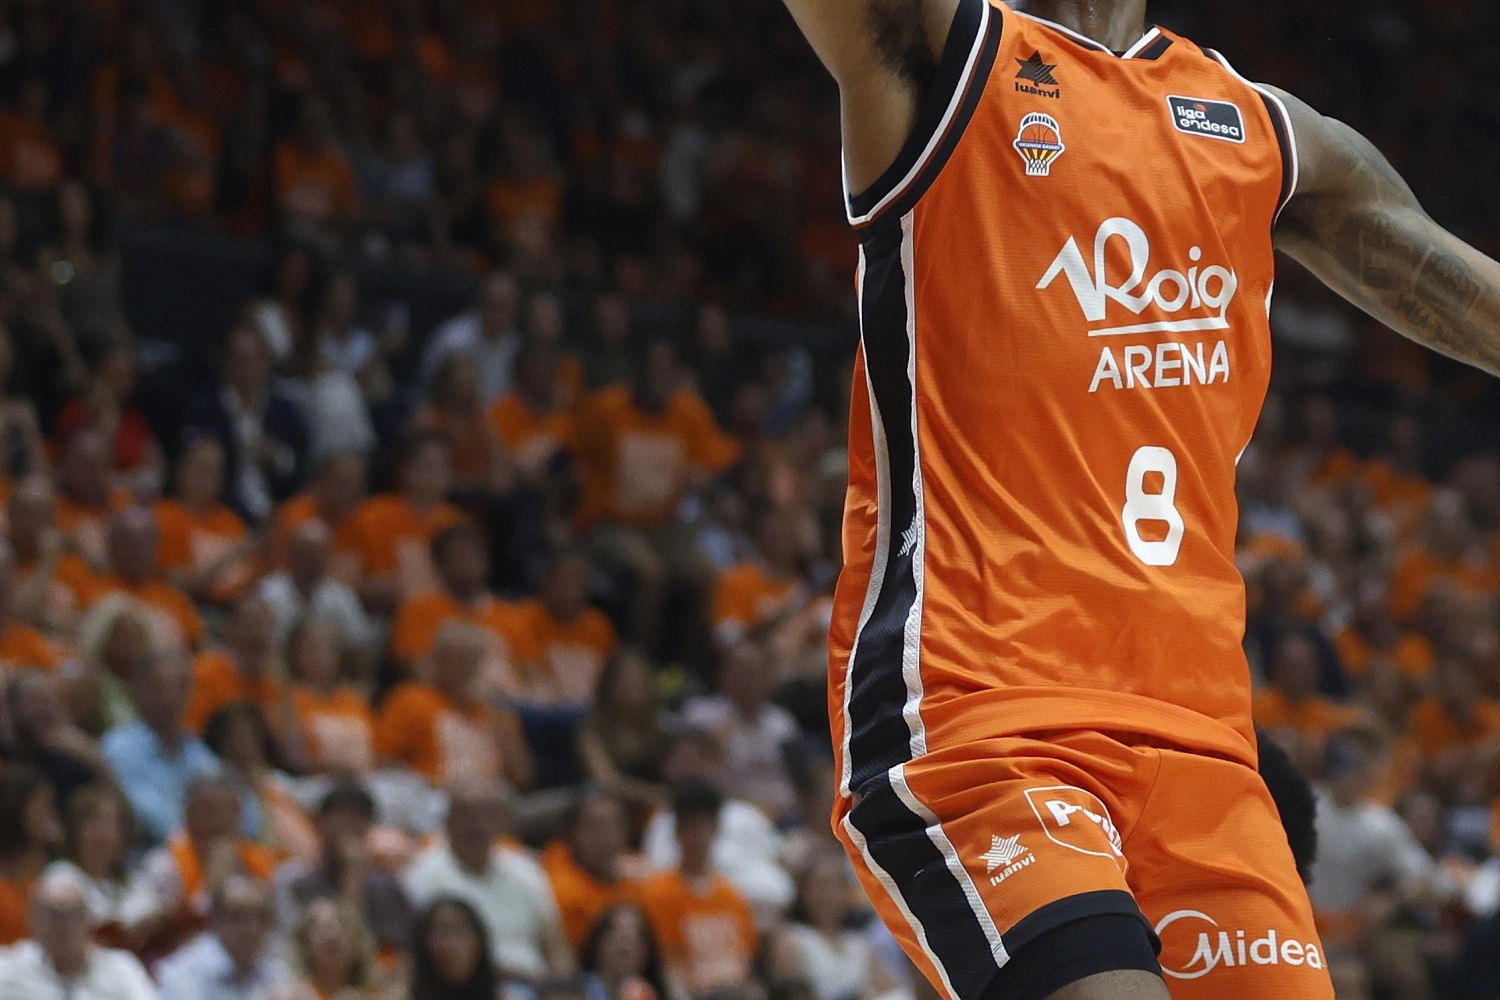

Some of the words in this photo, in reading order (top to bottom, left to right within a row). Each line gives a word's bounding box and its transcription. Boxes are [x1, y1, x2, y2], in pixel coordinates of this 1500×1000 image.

[1015, 81, 1060, 99] luanvi
[1176, 105, 1206, 120] liga
[1179, 117, 1240, 137] endesa
[1035, 217, 1238, 328] Roig
[1087, 340, 1230, 393] ARENA
[1121, 445, 1184, 566] 8
[989, 852, 1036, 887] luanvi
[1180, 928, 1323, 974] Midea
